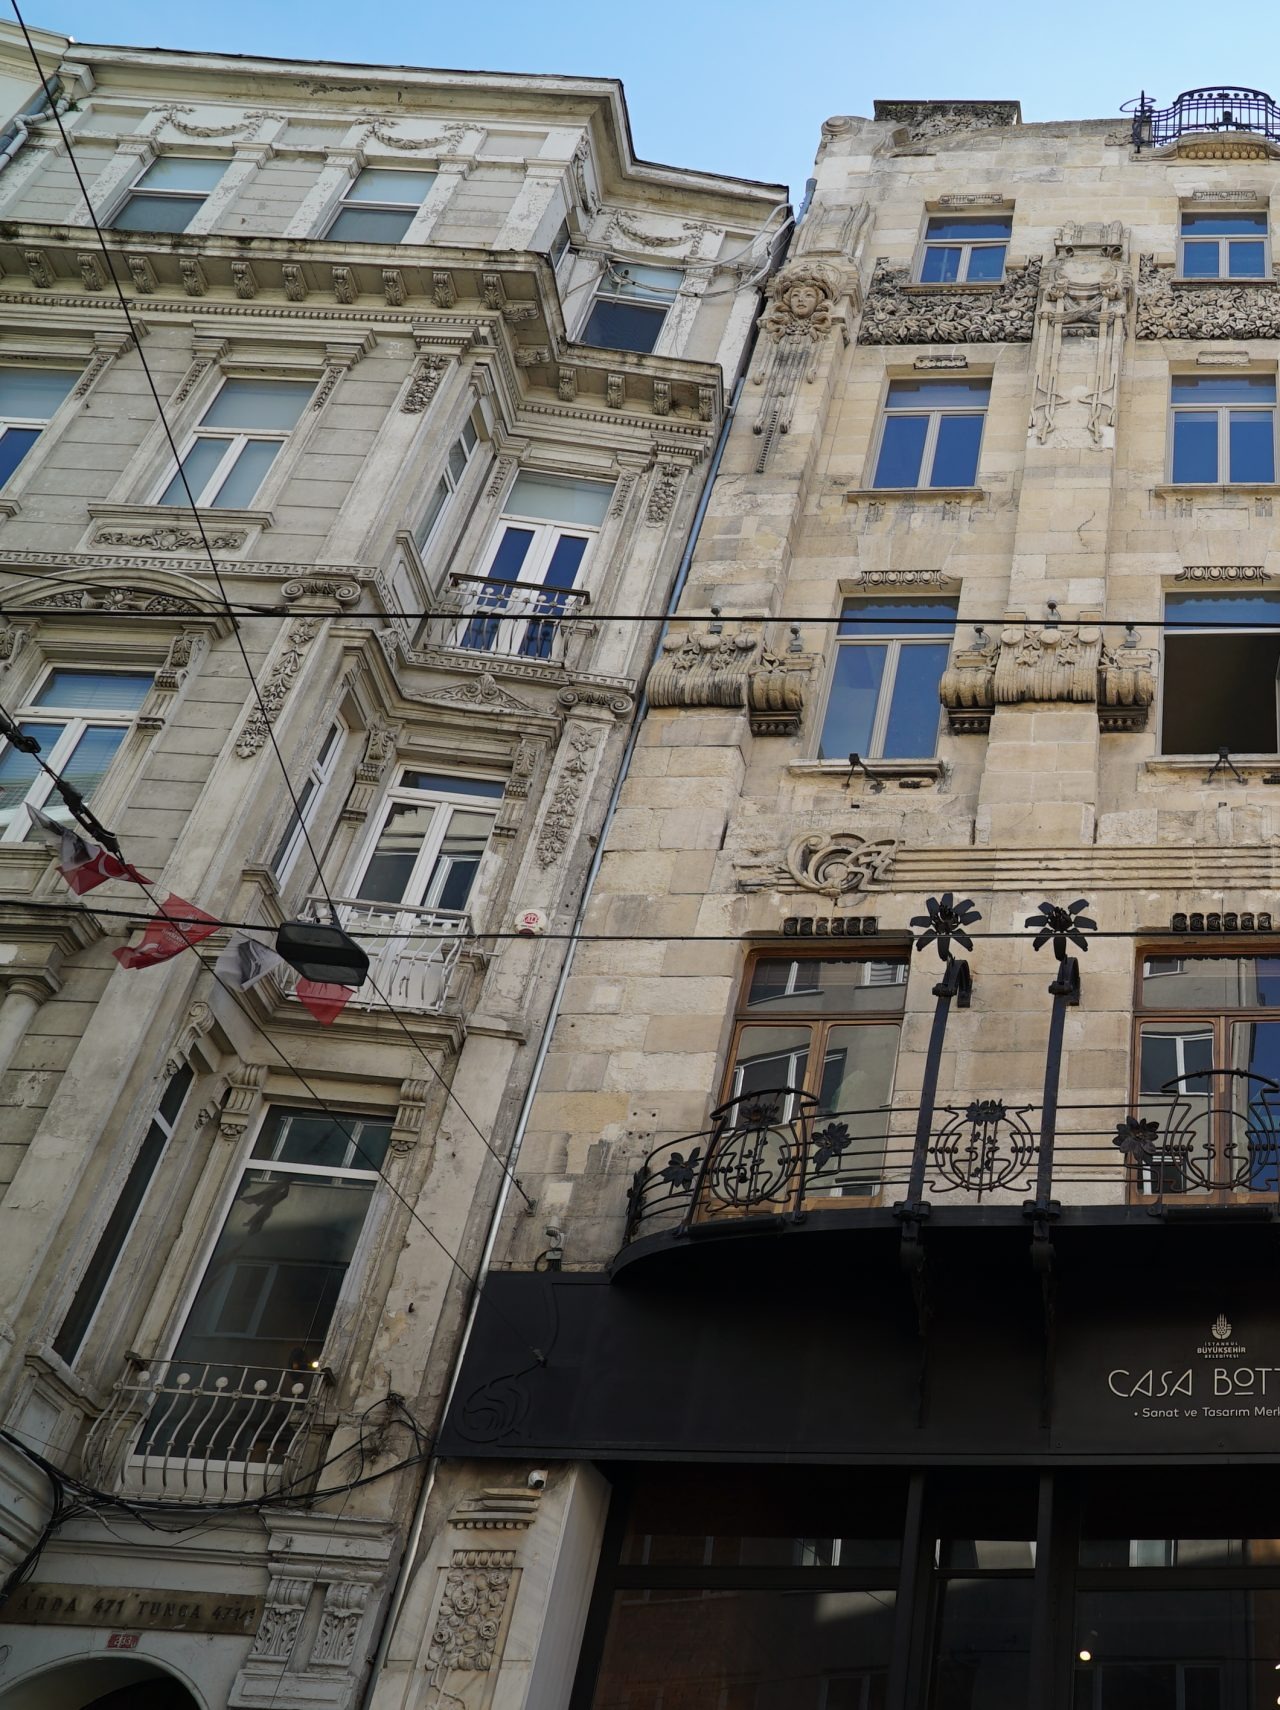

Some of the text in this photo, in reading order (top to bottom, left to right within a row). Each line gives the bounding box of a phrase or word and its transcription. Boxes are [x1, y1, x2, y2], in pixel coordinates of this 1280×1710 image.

[1197, 1346, 1246, 1354] BÜYÜKŞEHİR
[1108, 1369, 1193, 1397] CASA
[1142, 1407, 1179, 1418] Sanat
[1184, 1409, 1198, 1417] ve
[1202, 1407, 1250, 1418] Tasarım
[17, 1595, 76, 1613] ARDA
[93, 1598, 126, 1614] 471
